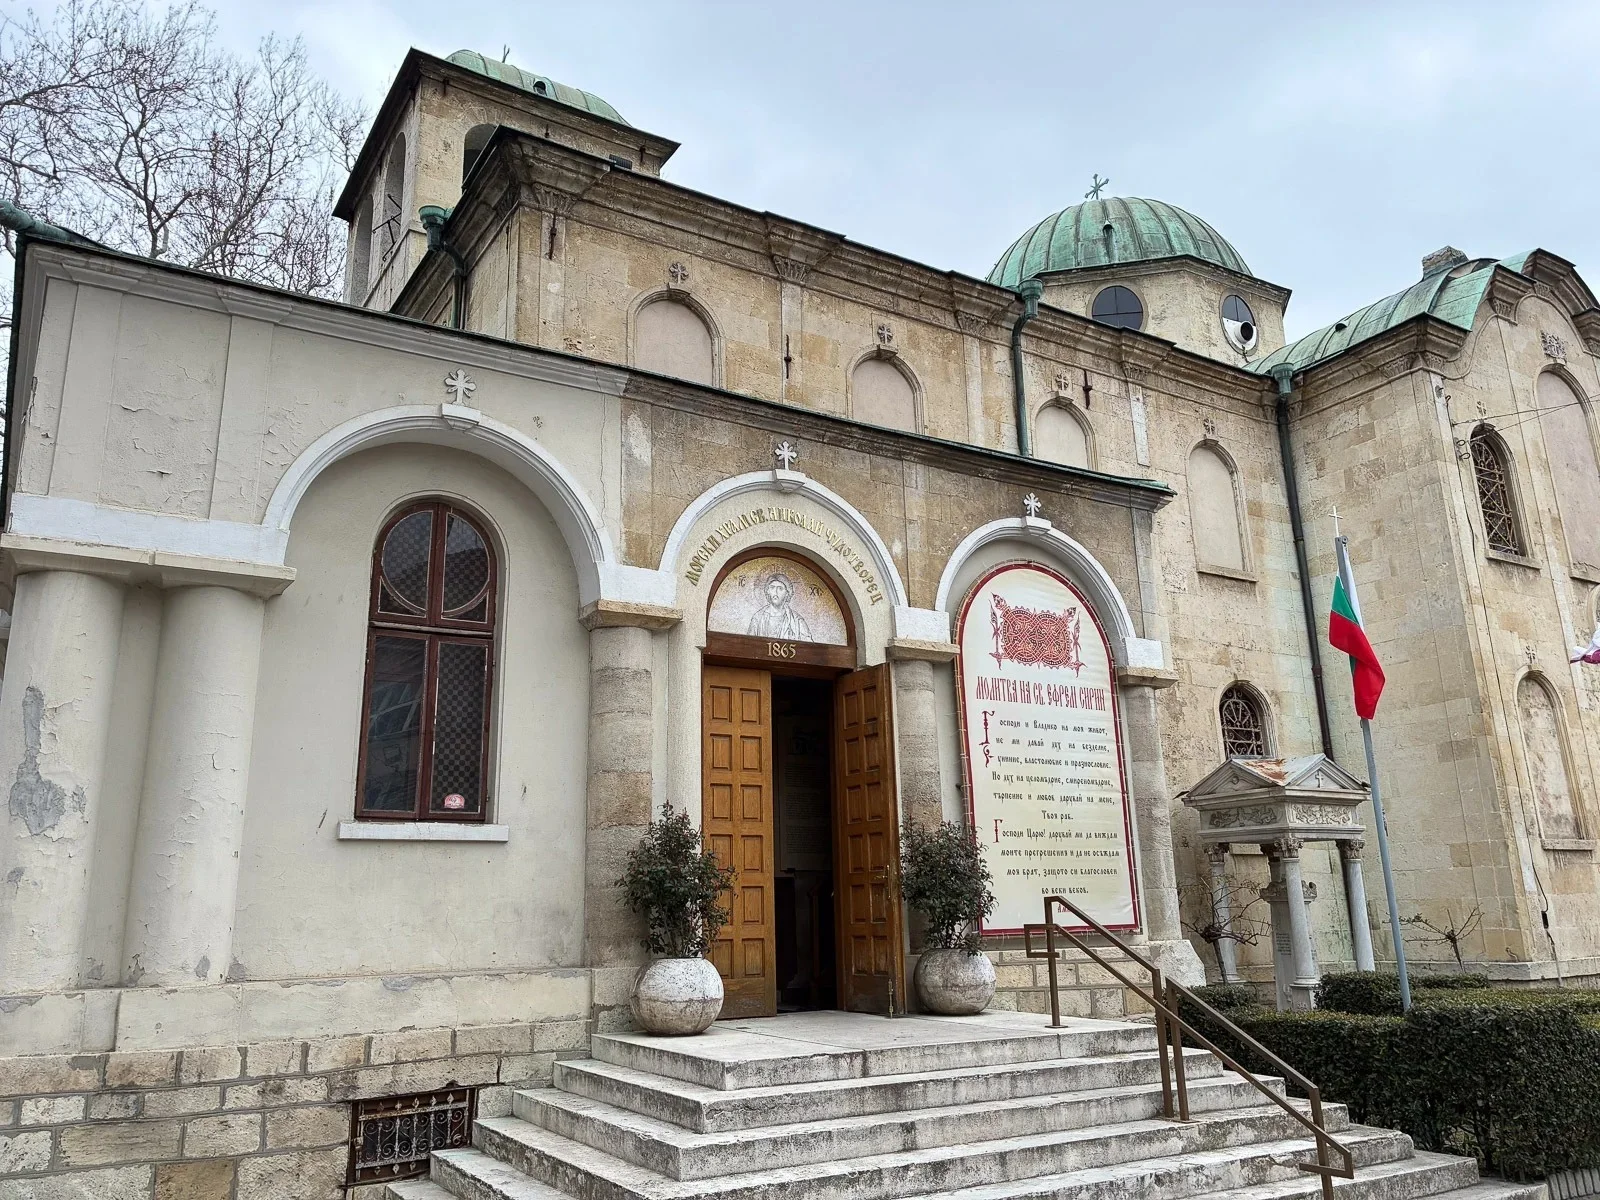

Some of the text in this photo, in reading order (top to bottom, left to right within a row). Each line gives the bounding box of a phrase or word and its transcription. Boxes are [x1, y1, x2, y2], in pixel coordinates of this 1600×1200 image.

[685, 506, 883, 606] МОРСКИ ХРАМ СВ. НИКОЛАЙ ЧУДОТВОРЕЦ
[767, 642, 797, 659] 1865
[976, 676, 1106, 711] МОЛИТВА НА СВ. ЕФРЕМ СИРИН
[1033, 719, 1057, 731] Владико
[1088, 727, 1108, 736] живот,
[1027, 738, 1045, 747] давай
[1051, 741, 1061, 752] дух
[1082, 743, 1110, 752] безделие,
[998, 755, 1022, 767] униние,
[1024, 757, 1062, 766] властолюбие
[1071, 760, 1112, 771] празнословие.
[992, 771, 1001, 780] Но
[1004, 774, 1014, 786] дух
[1026, 775, 1064, 787] целомъдрие,
[1065, 777, 1114, 789] смиреномъдрие,
[993, 793, 1023, 803] търпение
[1060, 793, 1083, 806] дарувай
[1099, 796, 1115, 805] мене,
[1041, 810, 1074, 823] Твоя раб.
[1026, 828, 1046, 842] Царю!
[1049, 829, 1072, 842] дарувай
[1086, 832, 1092, 840] да
[1094, 832, 1118, 840] виждам
[1001, 849, 1022, 857] моите
[1024, 849, 1068, 861] прегрешения
[1076, 850, 1083, 858] да
[1092, 850, 1120, 858] осъждам
[1022, 868, 1041, 880] брат,
[1043, 869, 1068, 879] защото
